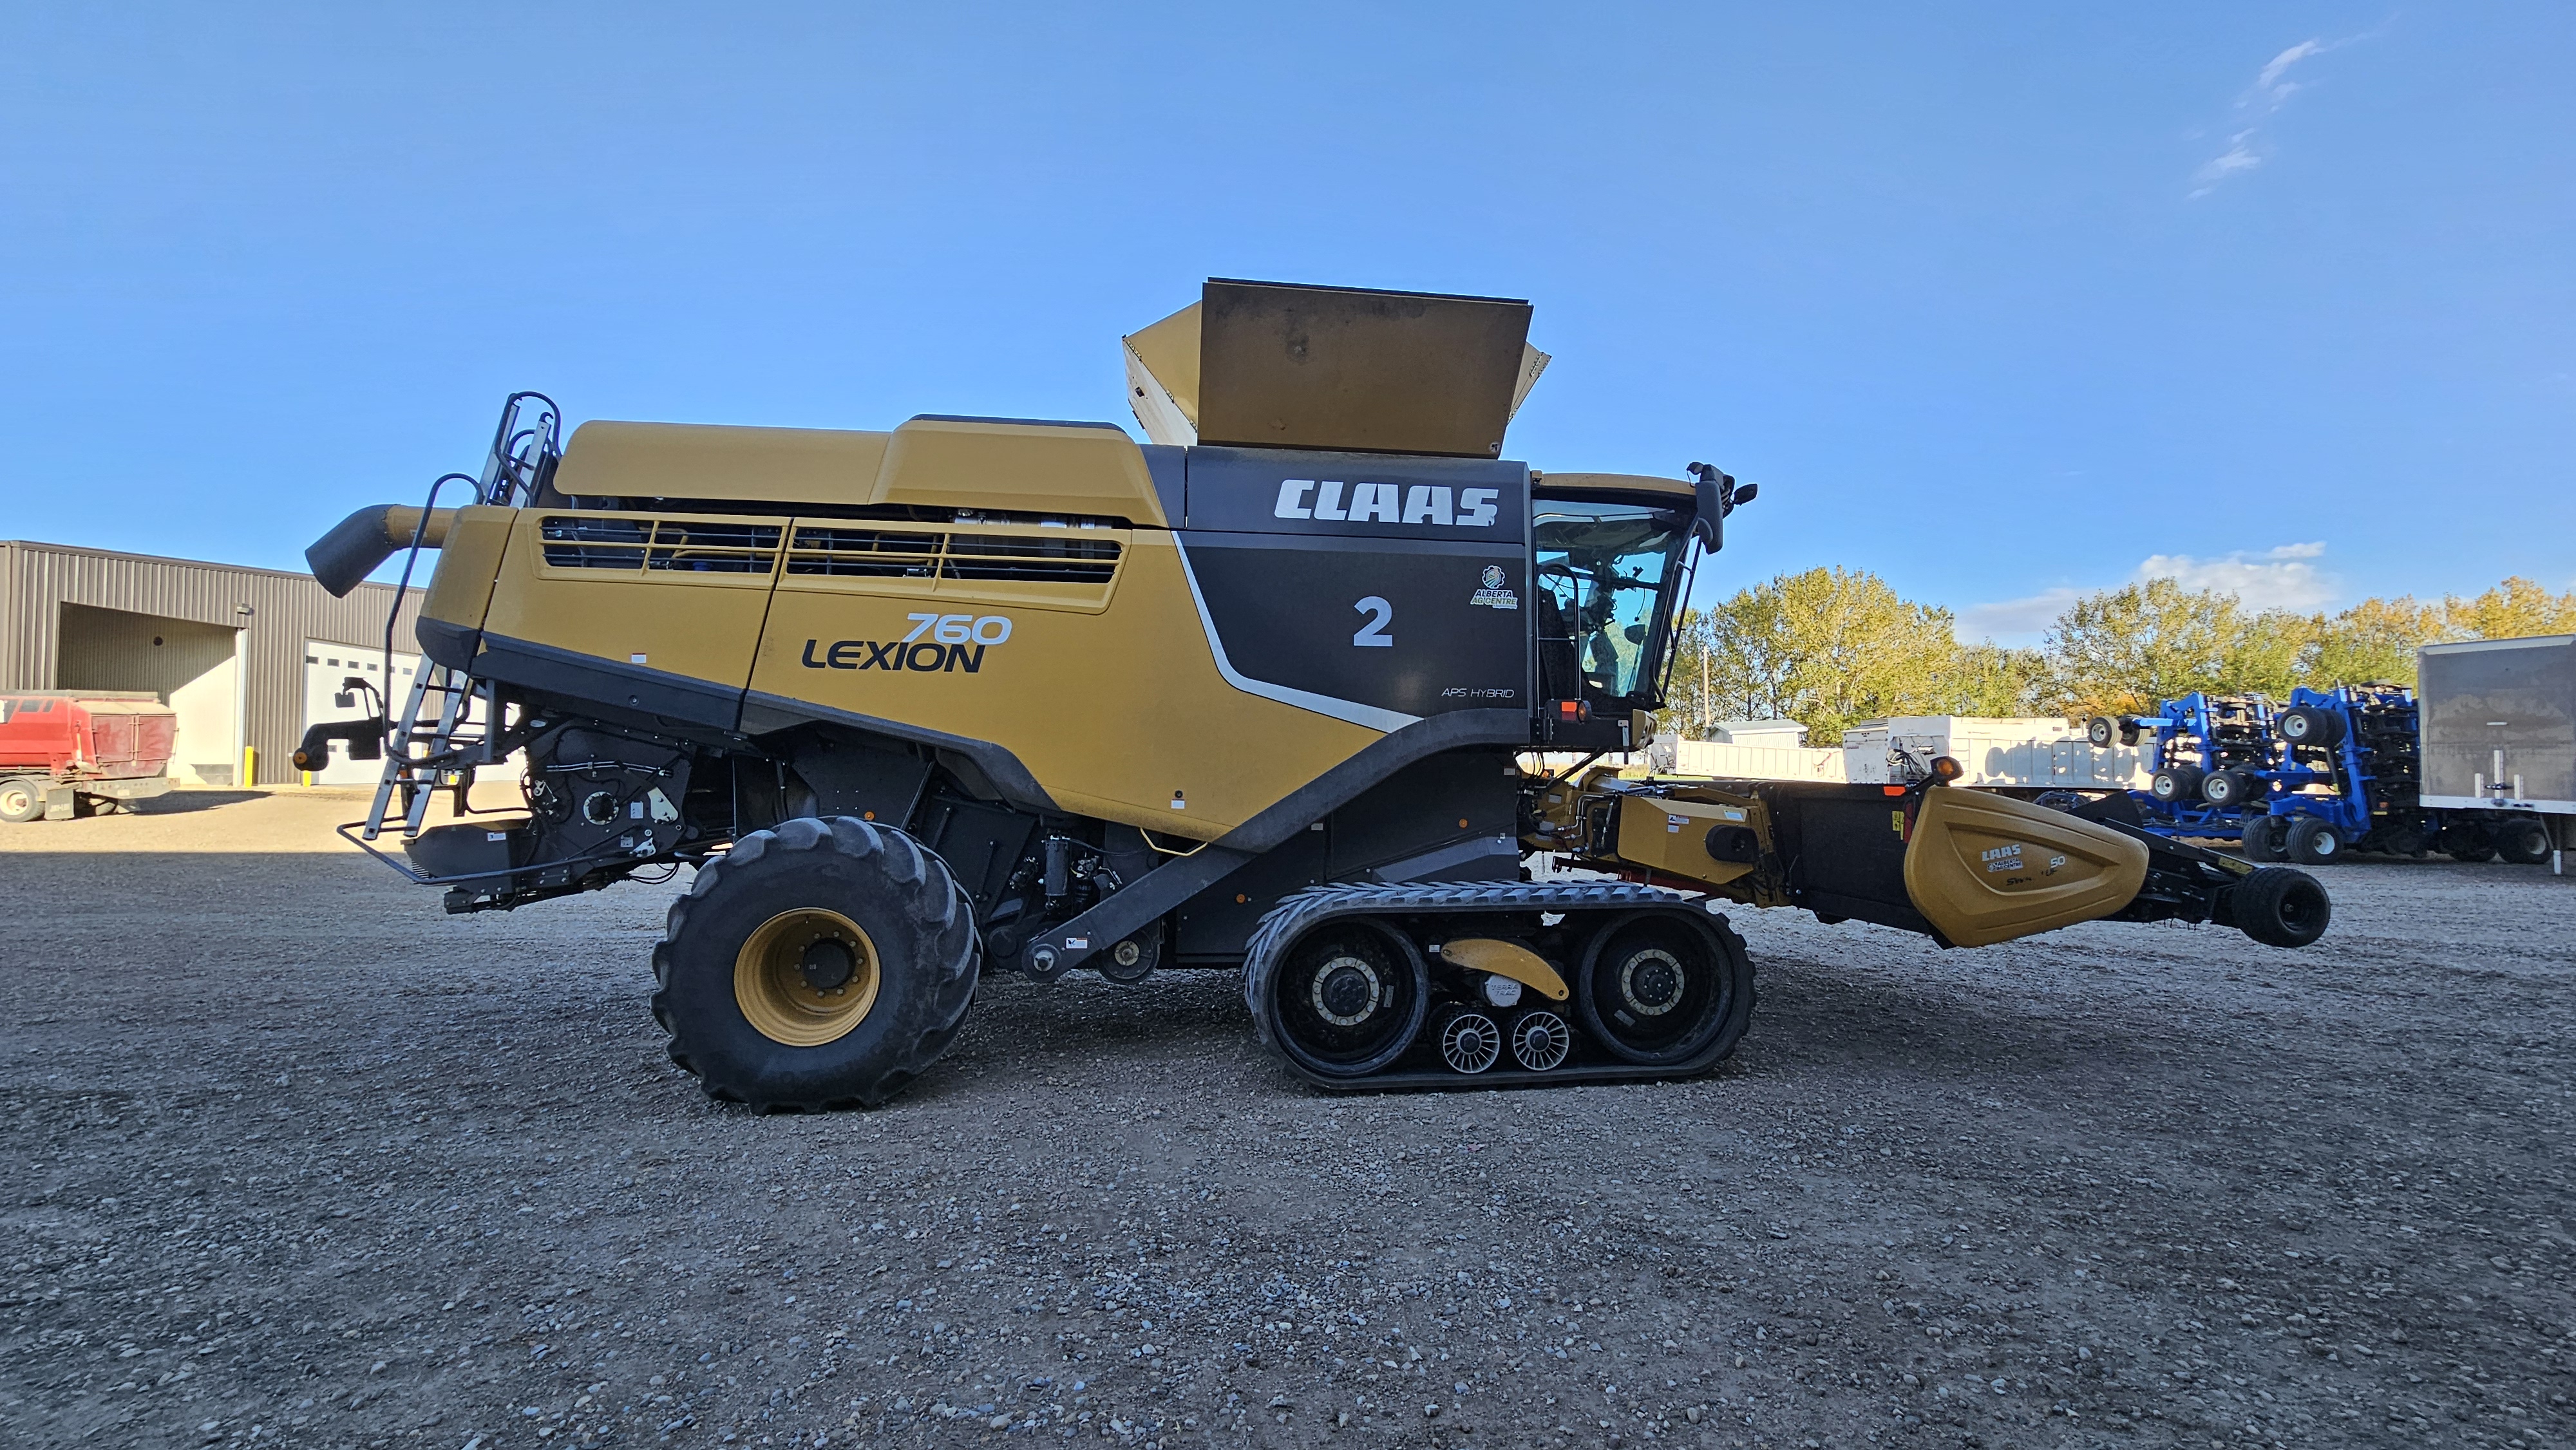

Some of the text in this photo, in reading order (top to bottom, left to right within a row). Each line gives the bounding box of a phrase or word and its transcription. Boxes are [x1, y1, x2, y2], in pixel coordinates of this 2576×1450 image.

[1274, 479, 1499, 527] CLAAS
[1485, 597, 1517, 605] CENTRE
[902, 612, 1013, 646] 760
[1353, 596, 1394, 647] 2
[801, 639, 987, 673] LEXION
[1441, 688, 1515, 699] APS HYBRID
